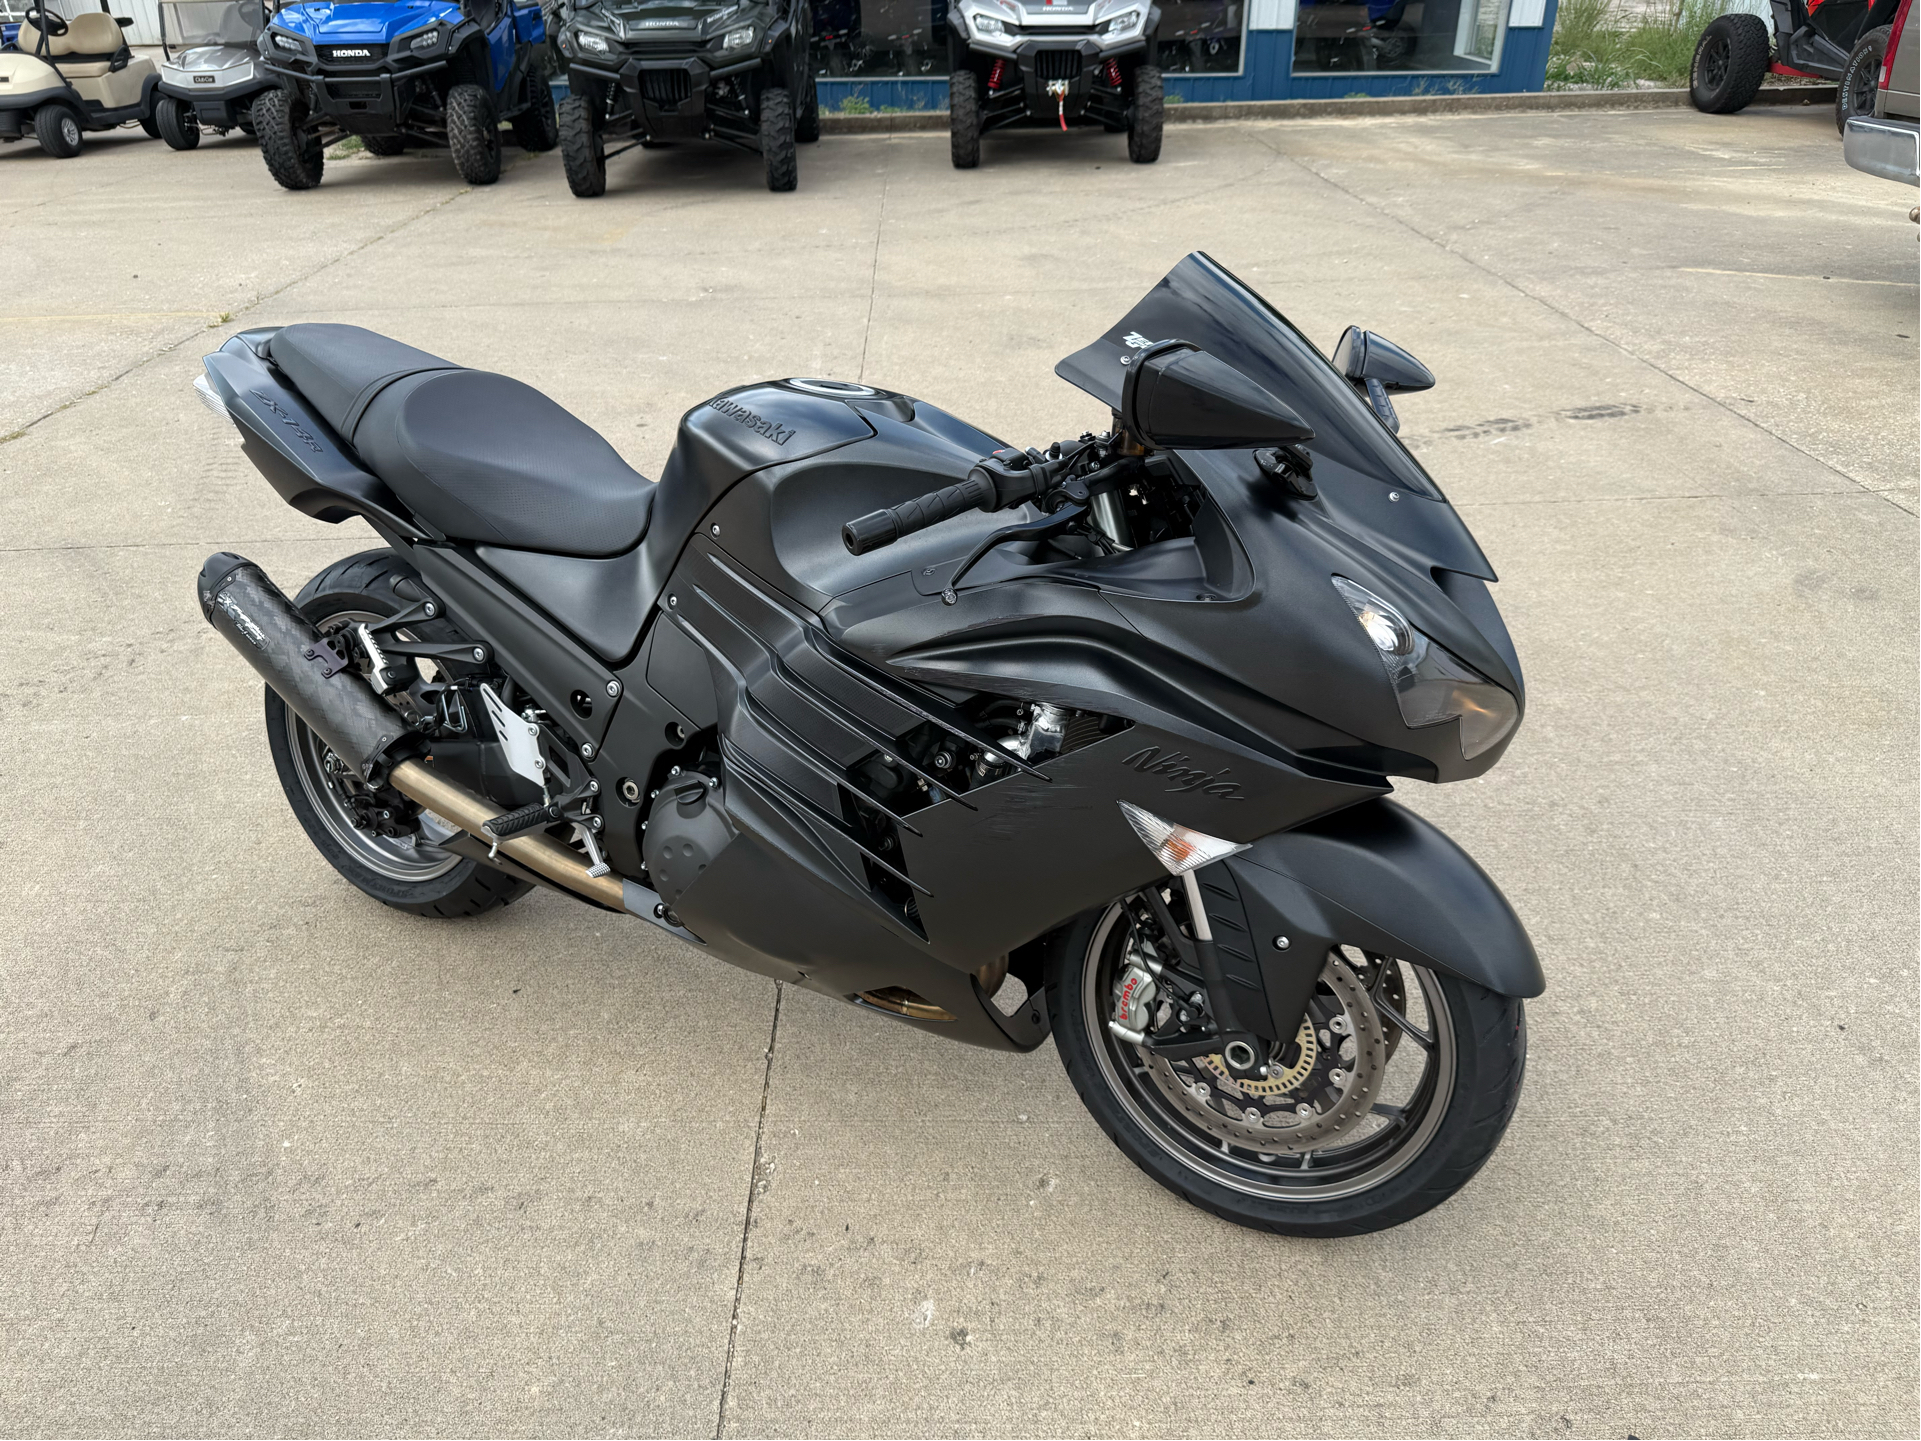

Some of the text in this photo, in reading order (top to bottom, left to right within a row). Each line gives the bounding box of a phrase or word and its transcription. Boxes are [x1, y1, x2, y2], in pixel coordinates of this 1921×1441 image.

[332, 49, 371, 57] HONDA
[250, 389, 323, 453] ZX-14R
[1122, 746, 1245, 800] Ninja
[1119, 977, 1138, 1021] brembo
